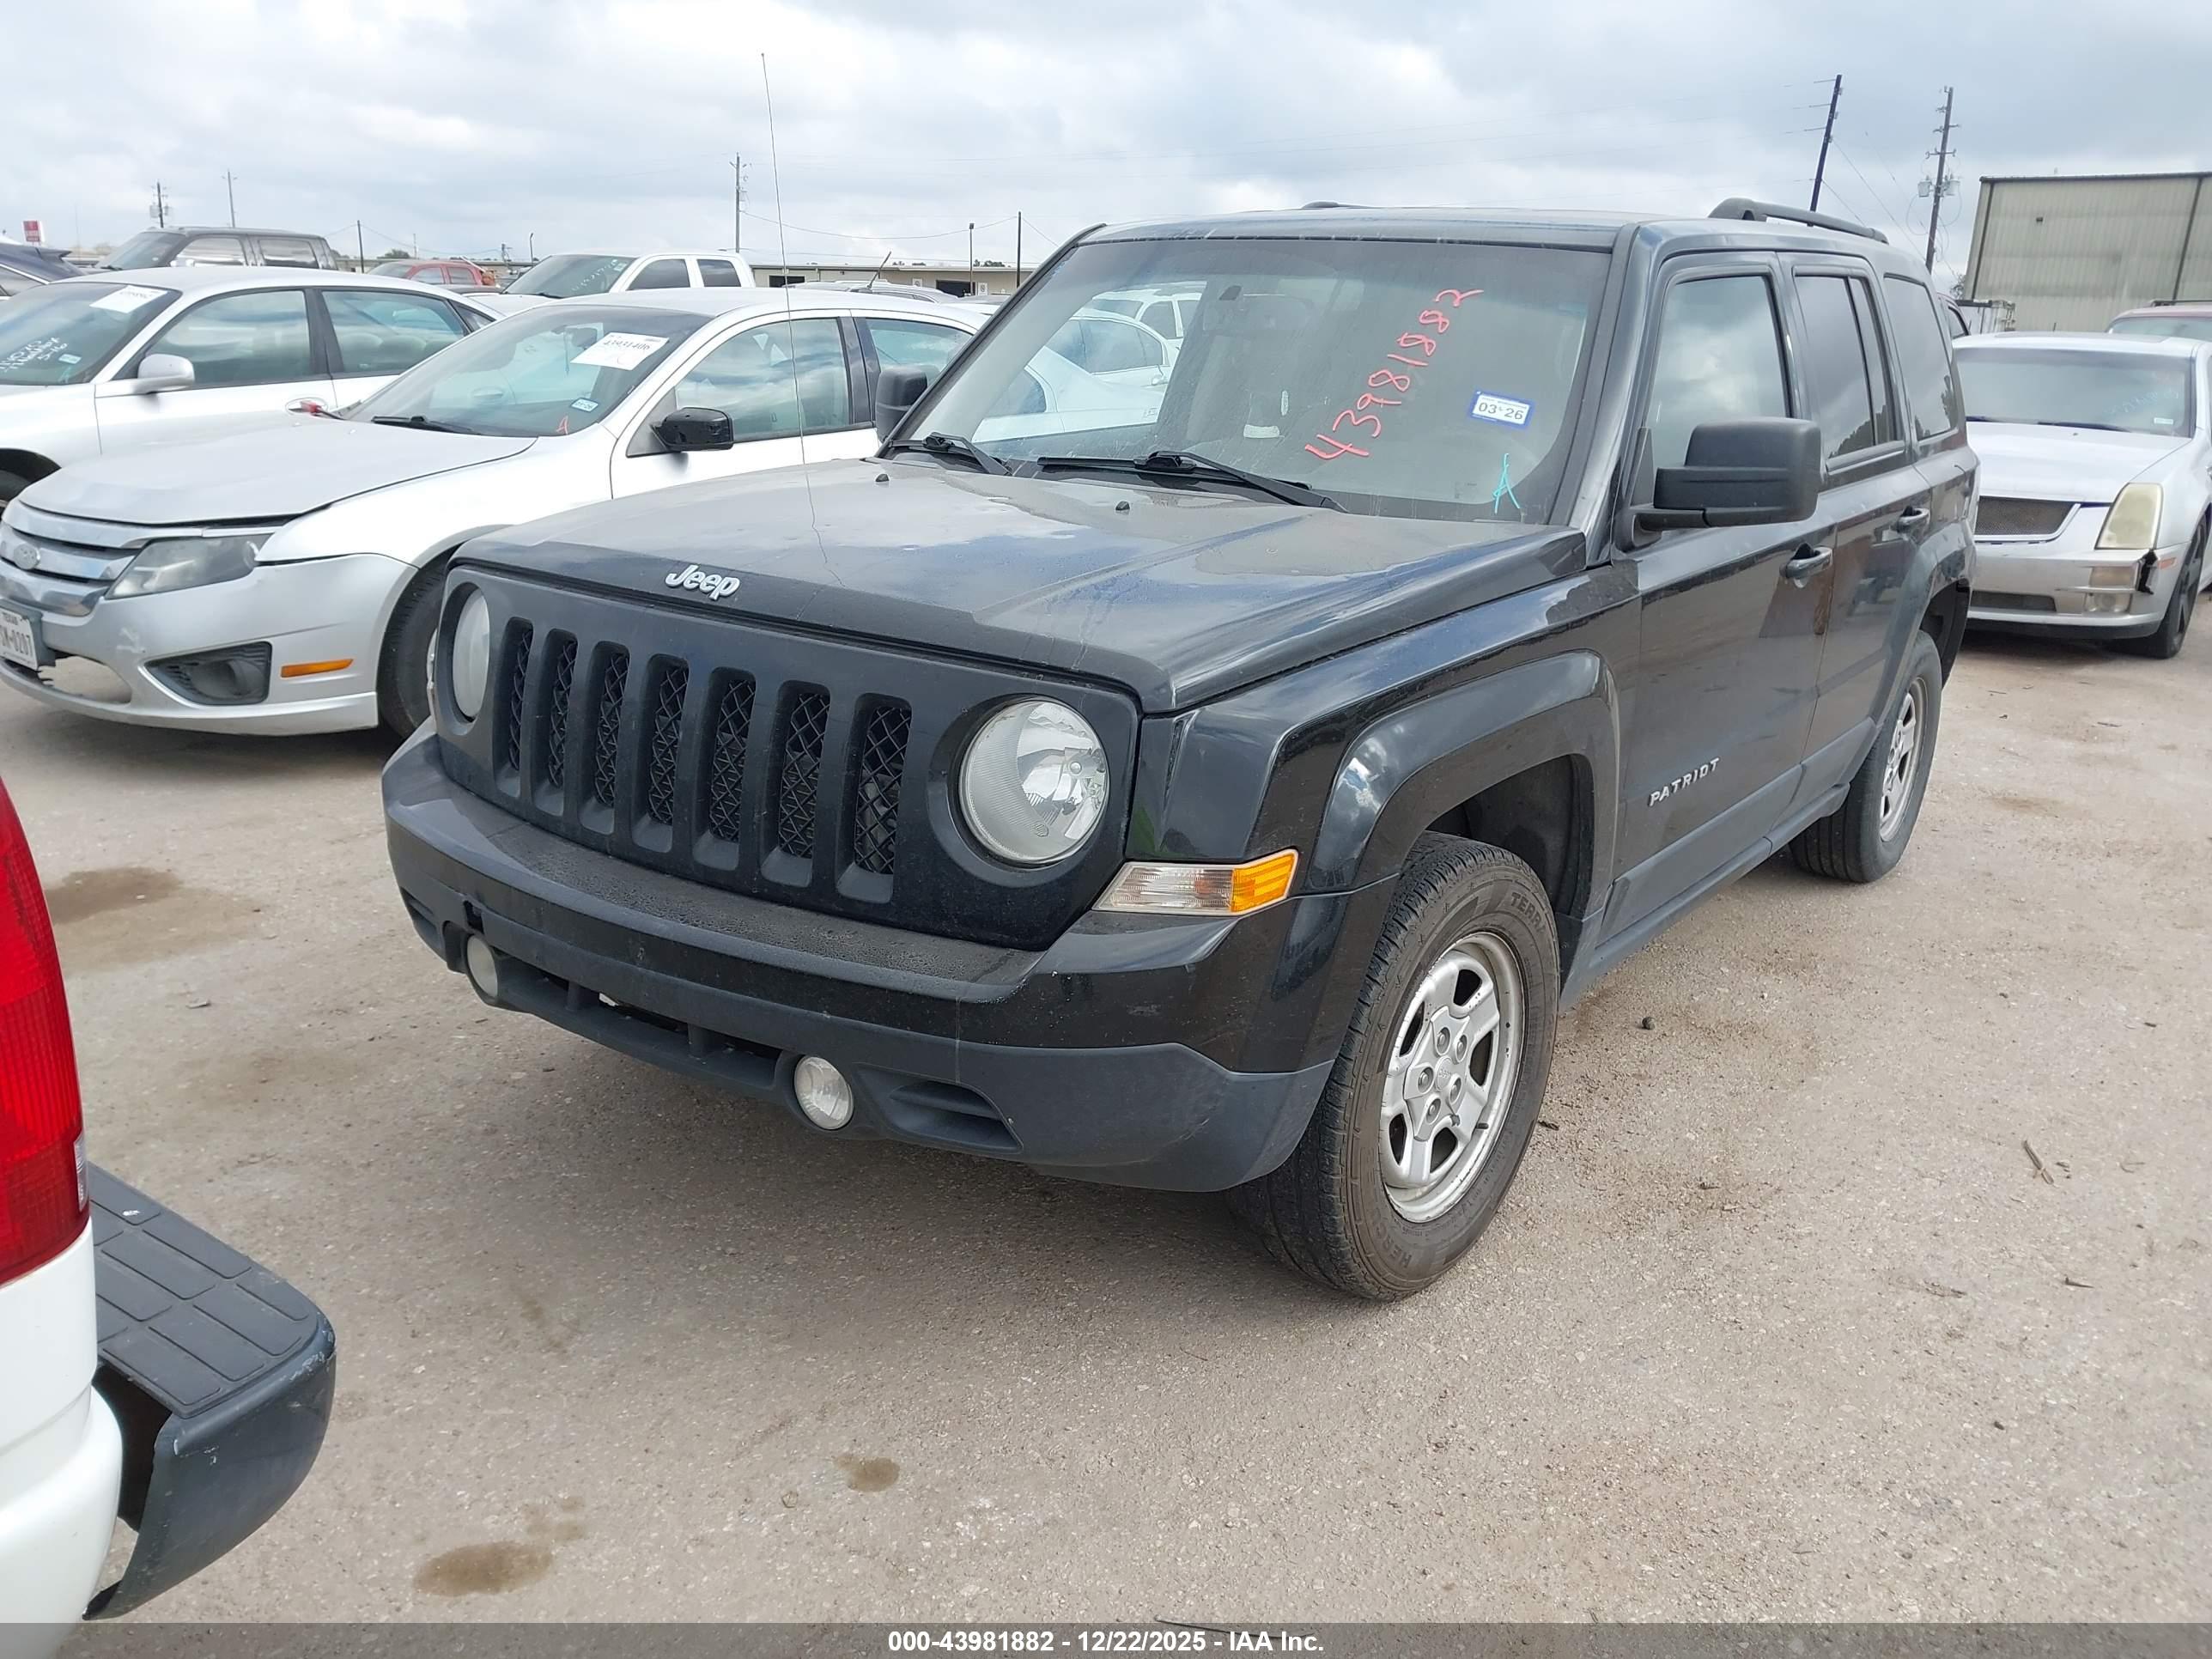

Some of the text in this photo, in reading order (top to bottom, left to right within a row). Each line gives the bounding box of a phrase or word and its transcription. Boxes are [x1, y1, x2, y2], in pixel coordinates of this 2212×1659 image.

[1304, 289, 1485, 459] 43981882
[1478, 402, 1498, 415] 03
[1504, 407, 1524, 421] 26
[665, 564, 740, 601] Jeep
[1648, 757, 1720, 807] PATRIOT
